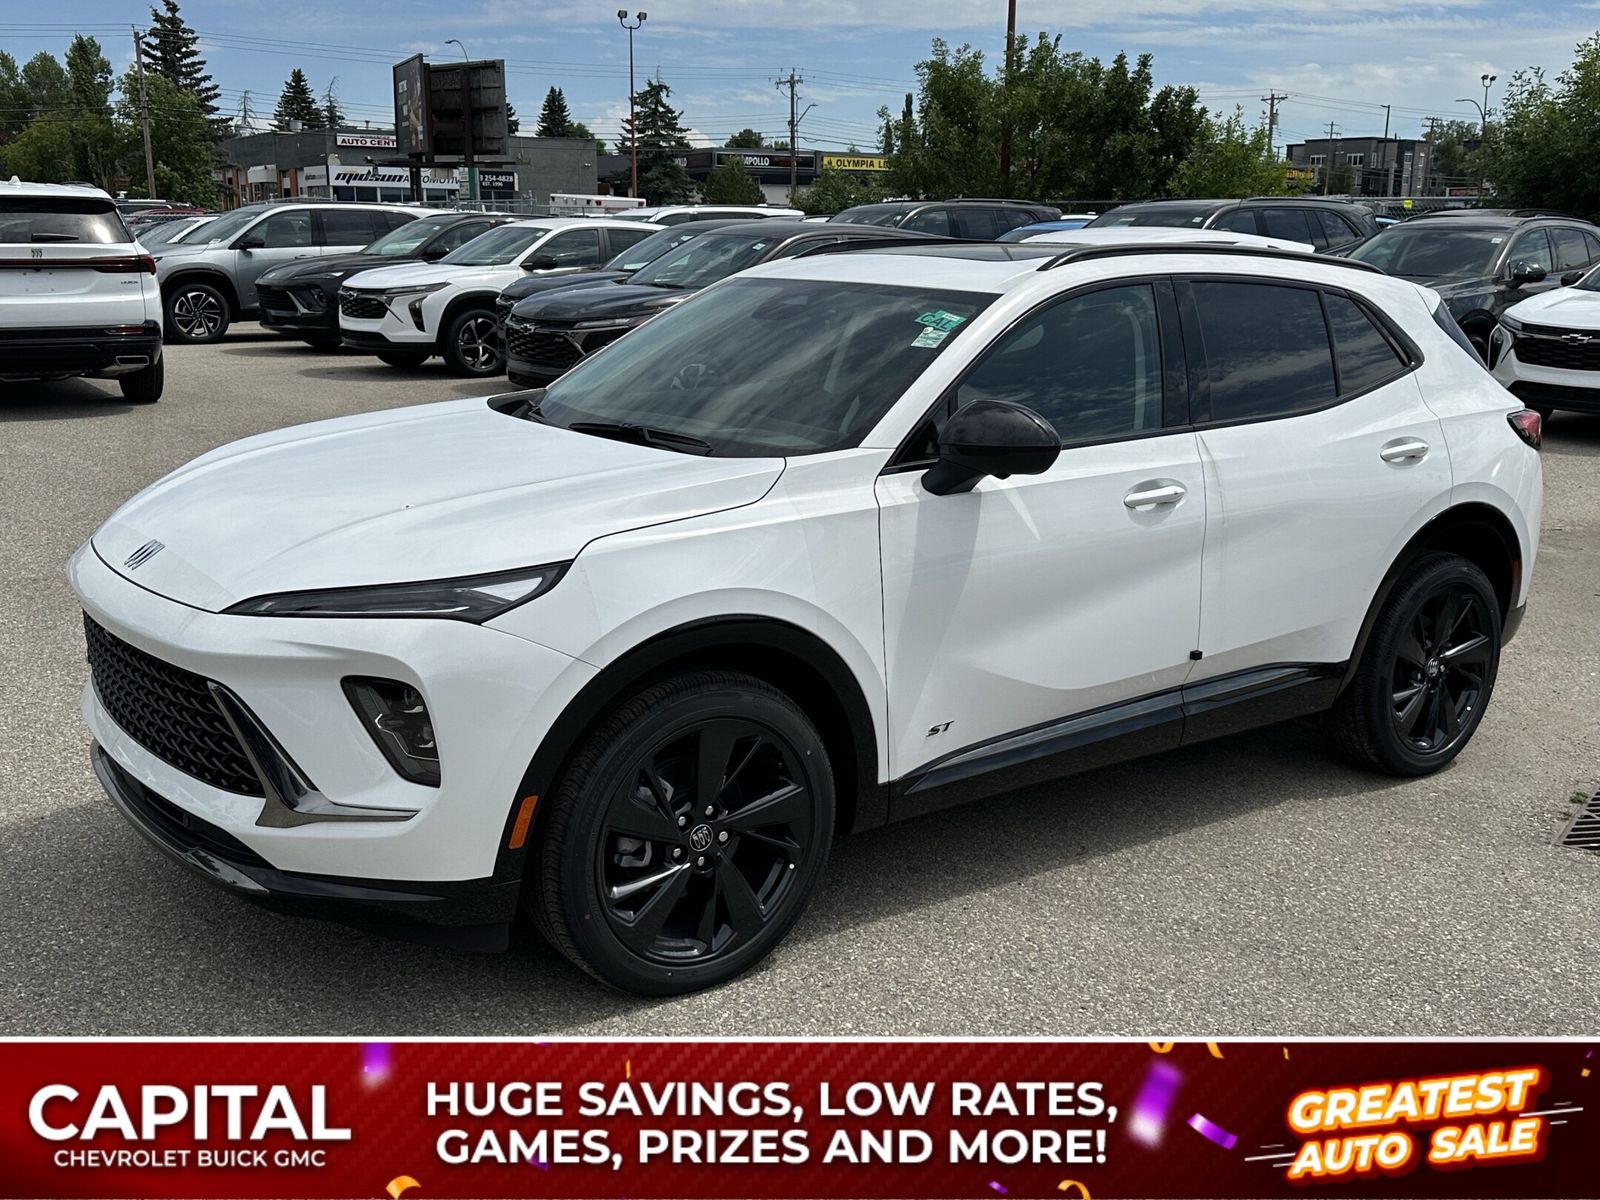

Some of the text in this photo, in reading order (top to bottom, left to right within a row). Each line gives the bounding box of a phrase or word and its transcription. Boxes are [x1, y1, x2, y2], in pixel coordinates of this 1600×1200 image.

[341, 138, 367, 146] AUTO
[836, 159, 875, 168] OLYMPIA
[484, 174, 514, 183] 254-4828
[926, 720, 955, 737] ST
